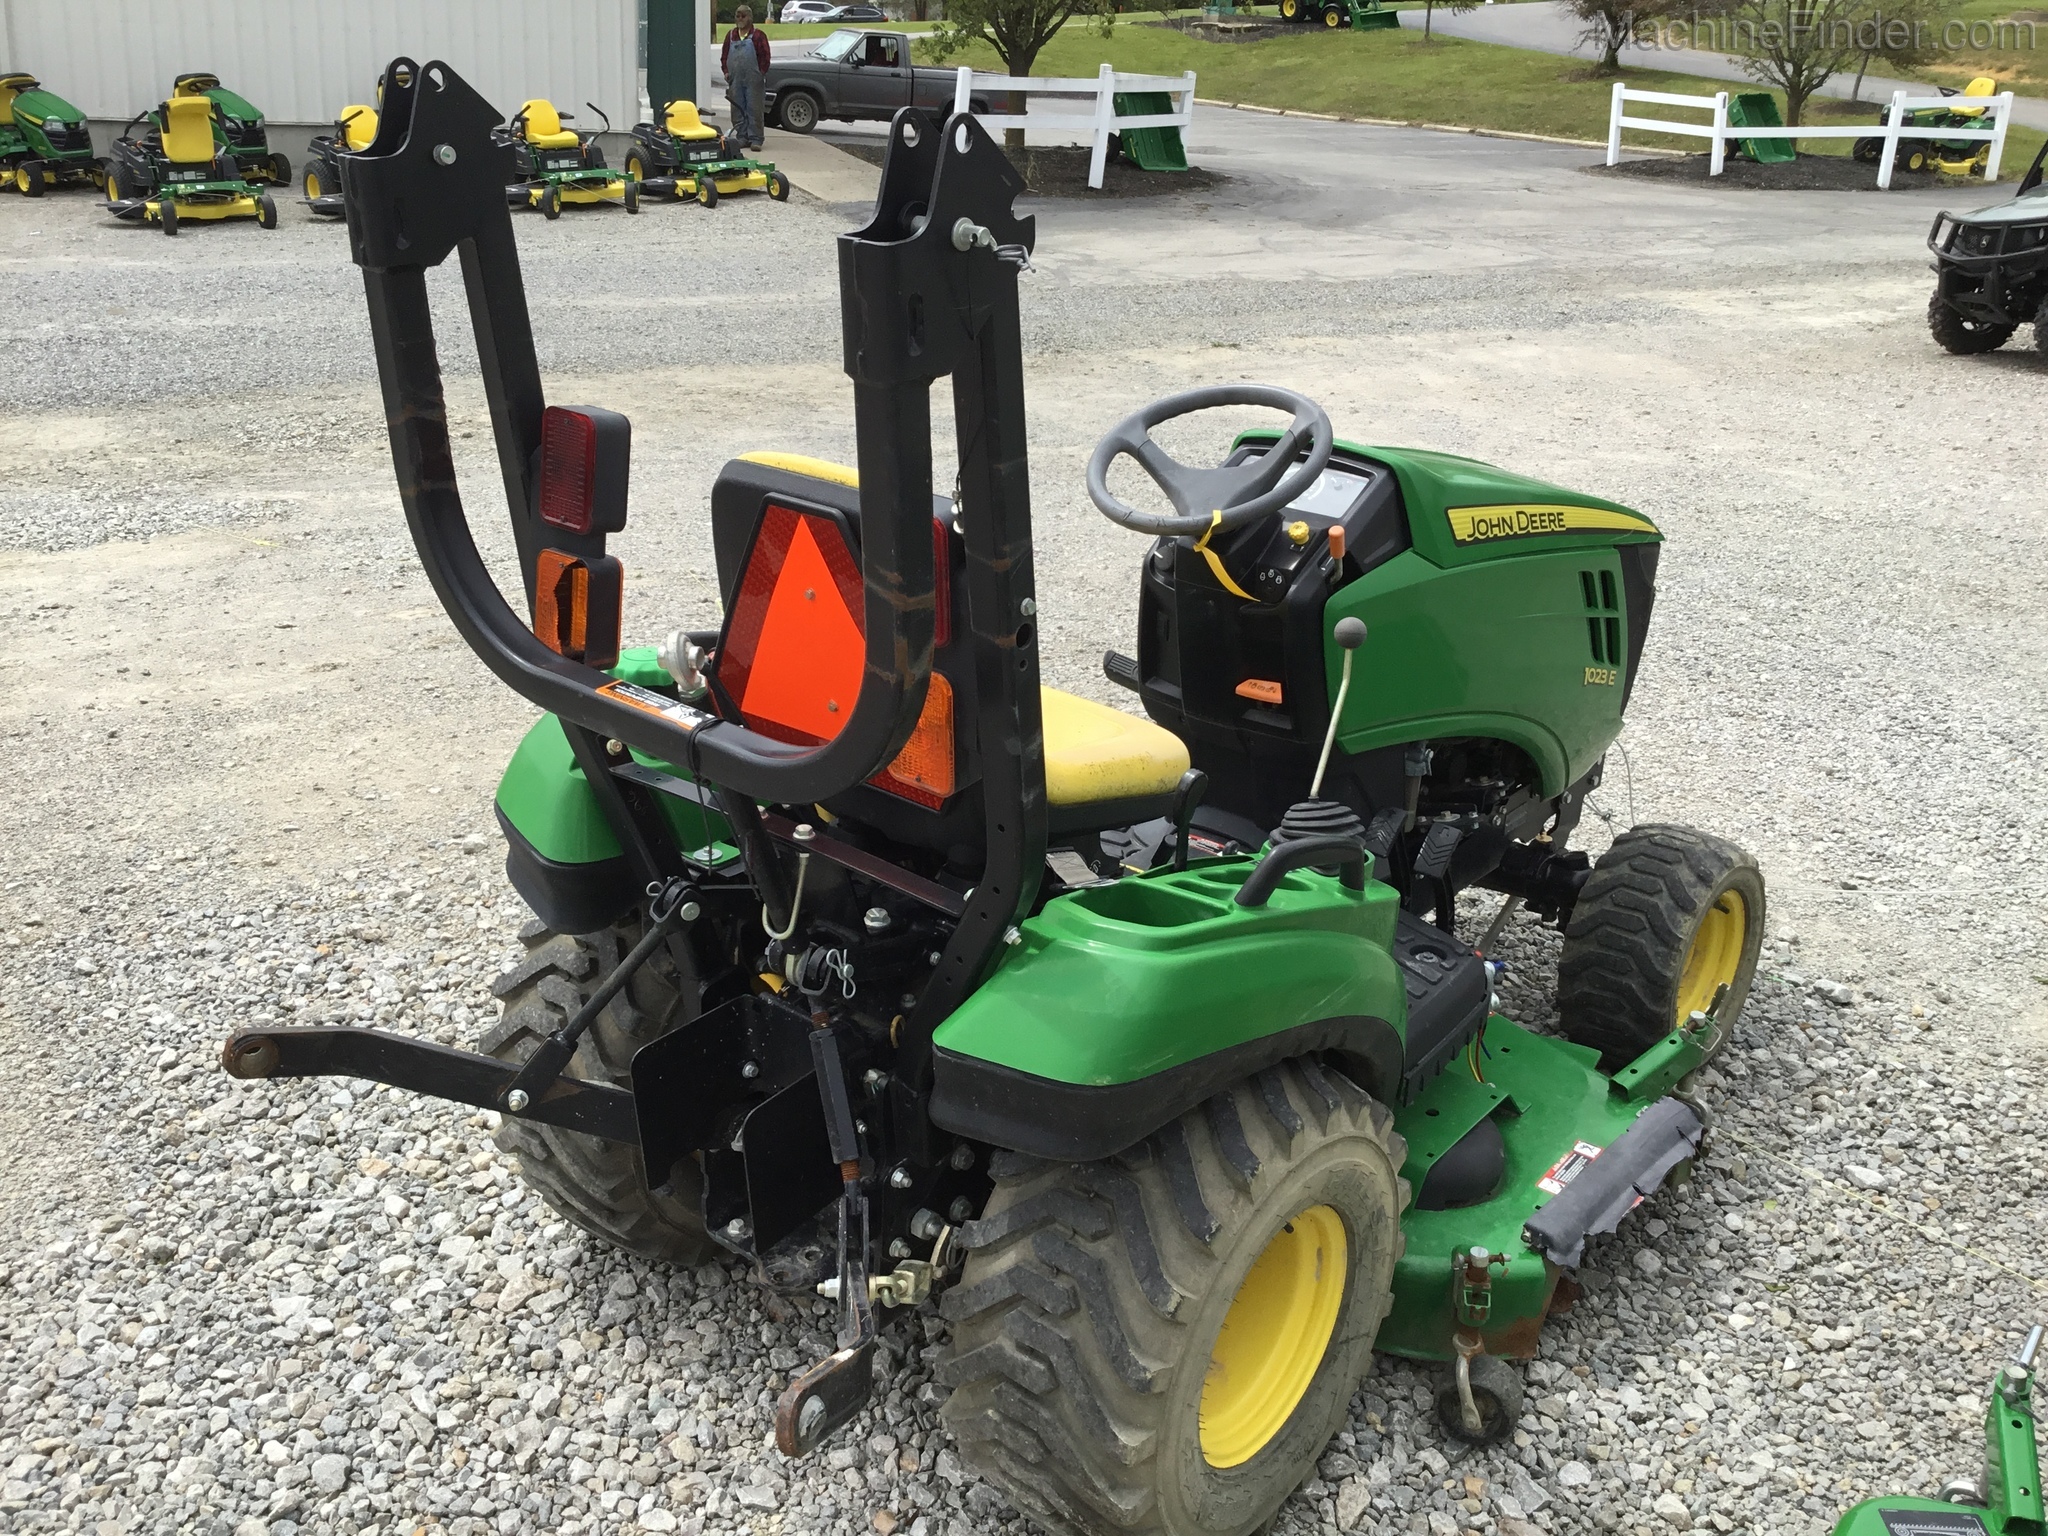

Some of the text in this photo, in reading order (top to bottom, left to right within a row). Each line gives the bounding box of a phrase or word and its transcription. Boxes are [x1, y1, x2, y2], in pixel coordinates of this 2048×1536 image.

[1467, 510, 1566, 538] JOHN DEERE
[1583, 667, 1617, 686] 1023 E
